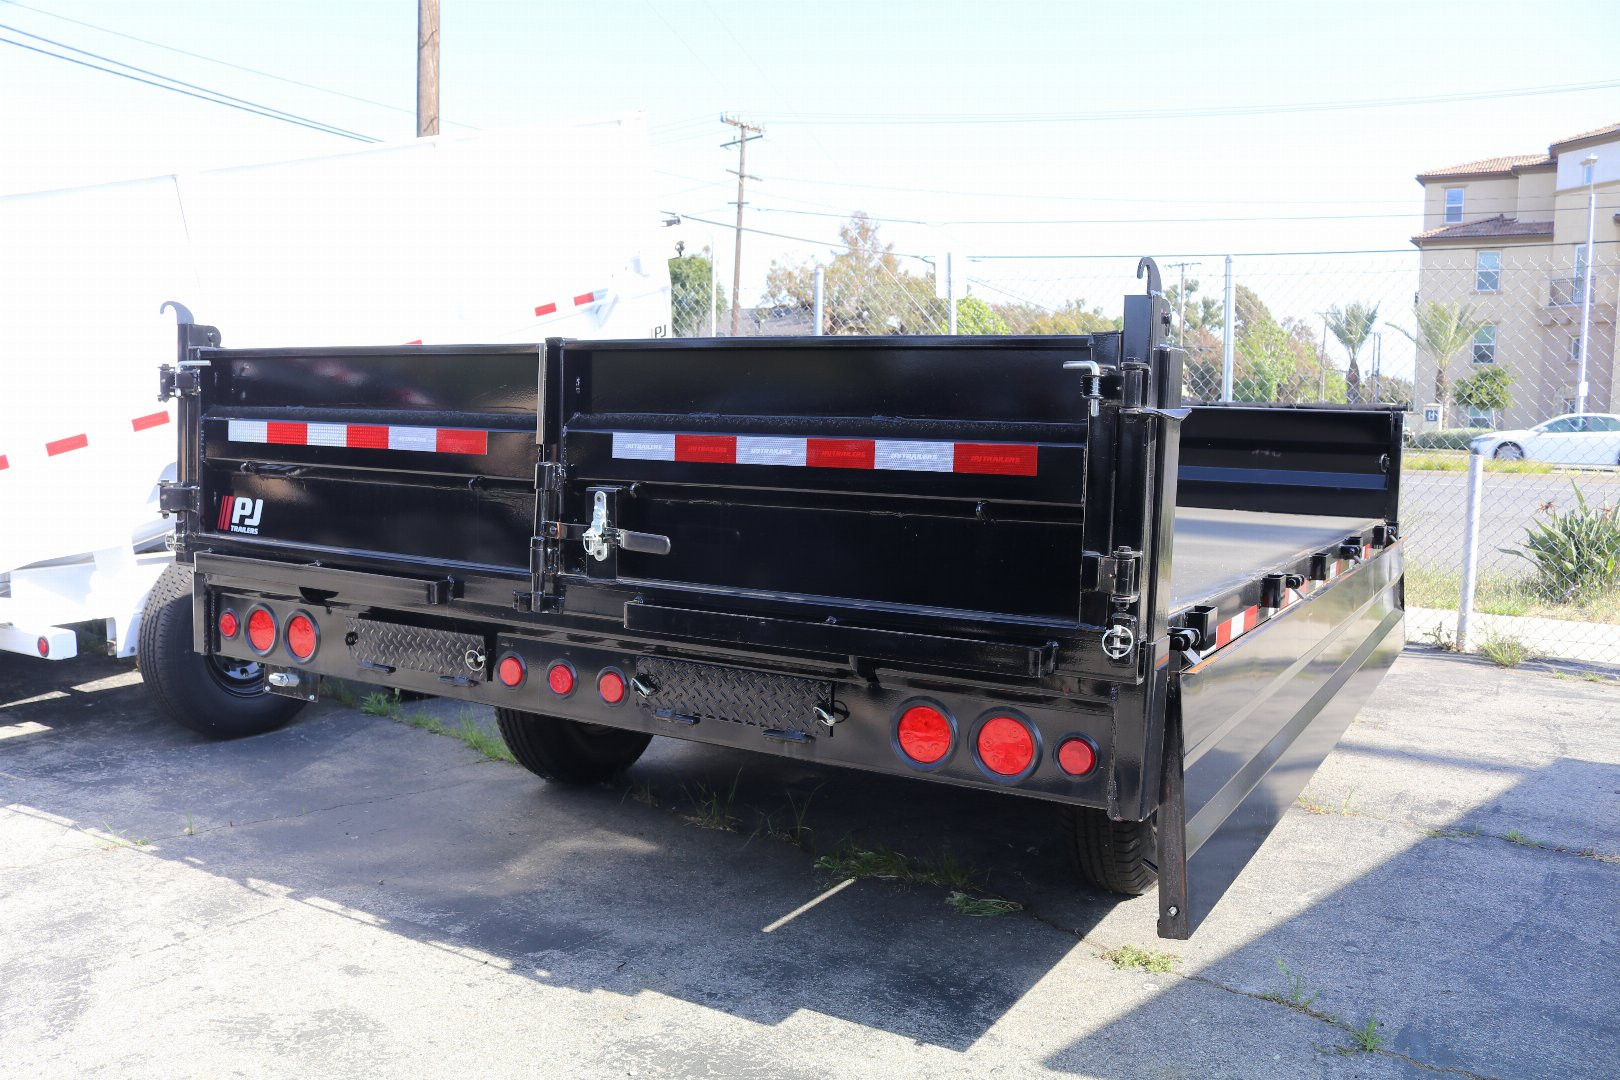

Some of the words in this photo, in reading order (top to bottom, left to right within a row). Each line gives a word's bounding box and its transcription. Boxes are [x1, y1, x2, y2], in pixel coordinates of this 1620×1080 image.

[654, 324, 667, 338] PJ
[231, 496, 264, 526] PJ
[230, 524, 259, 535] TRAILERS
